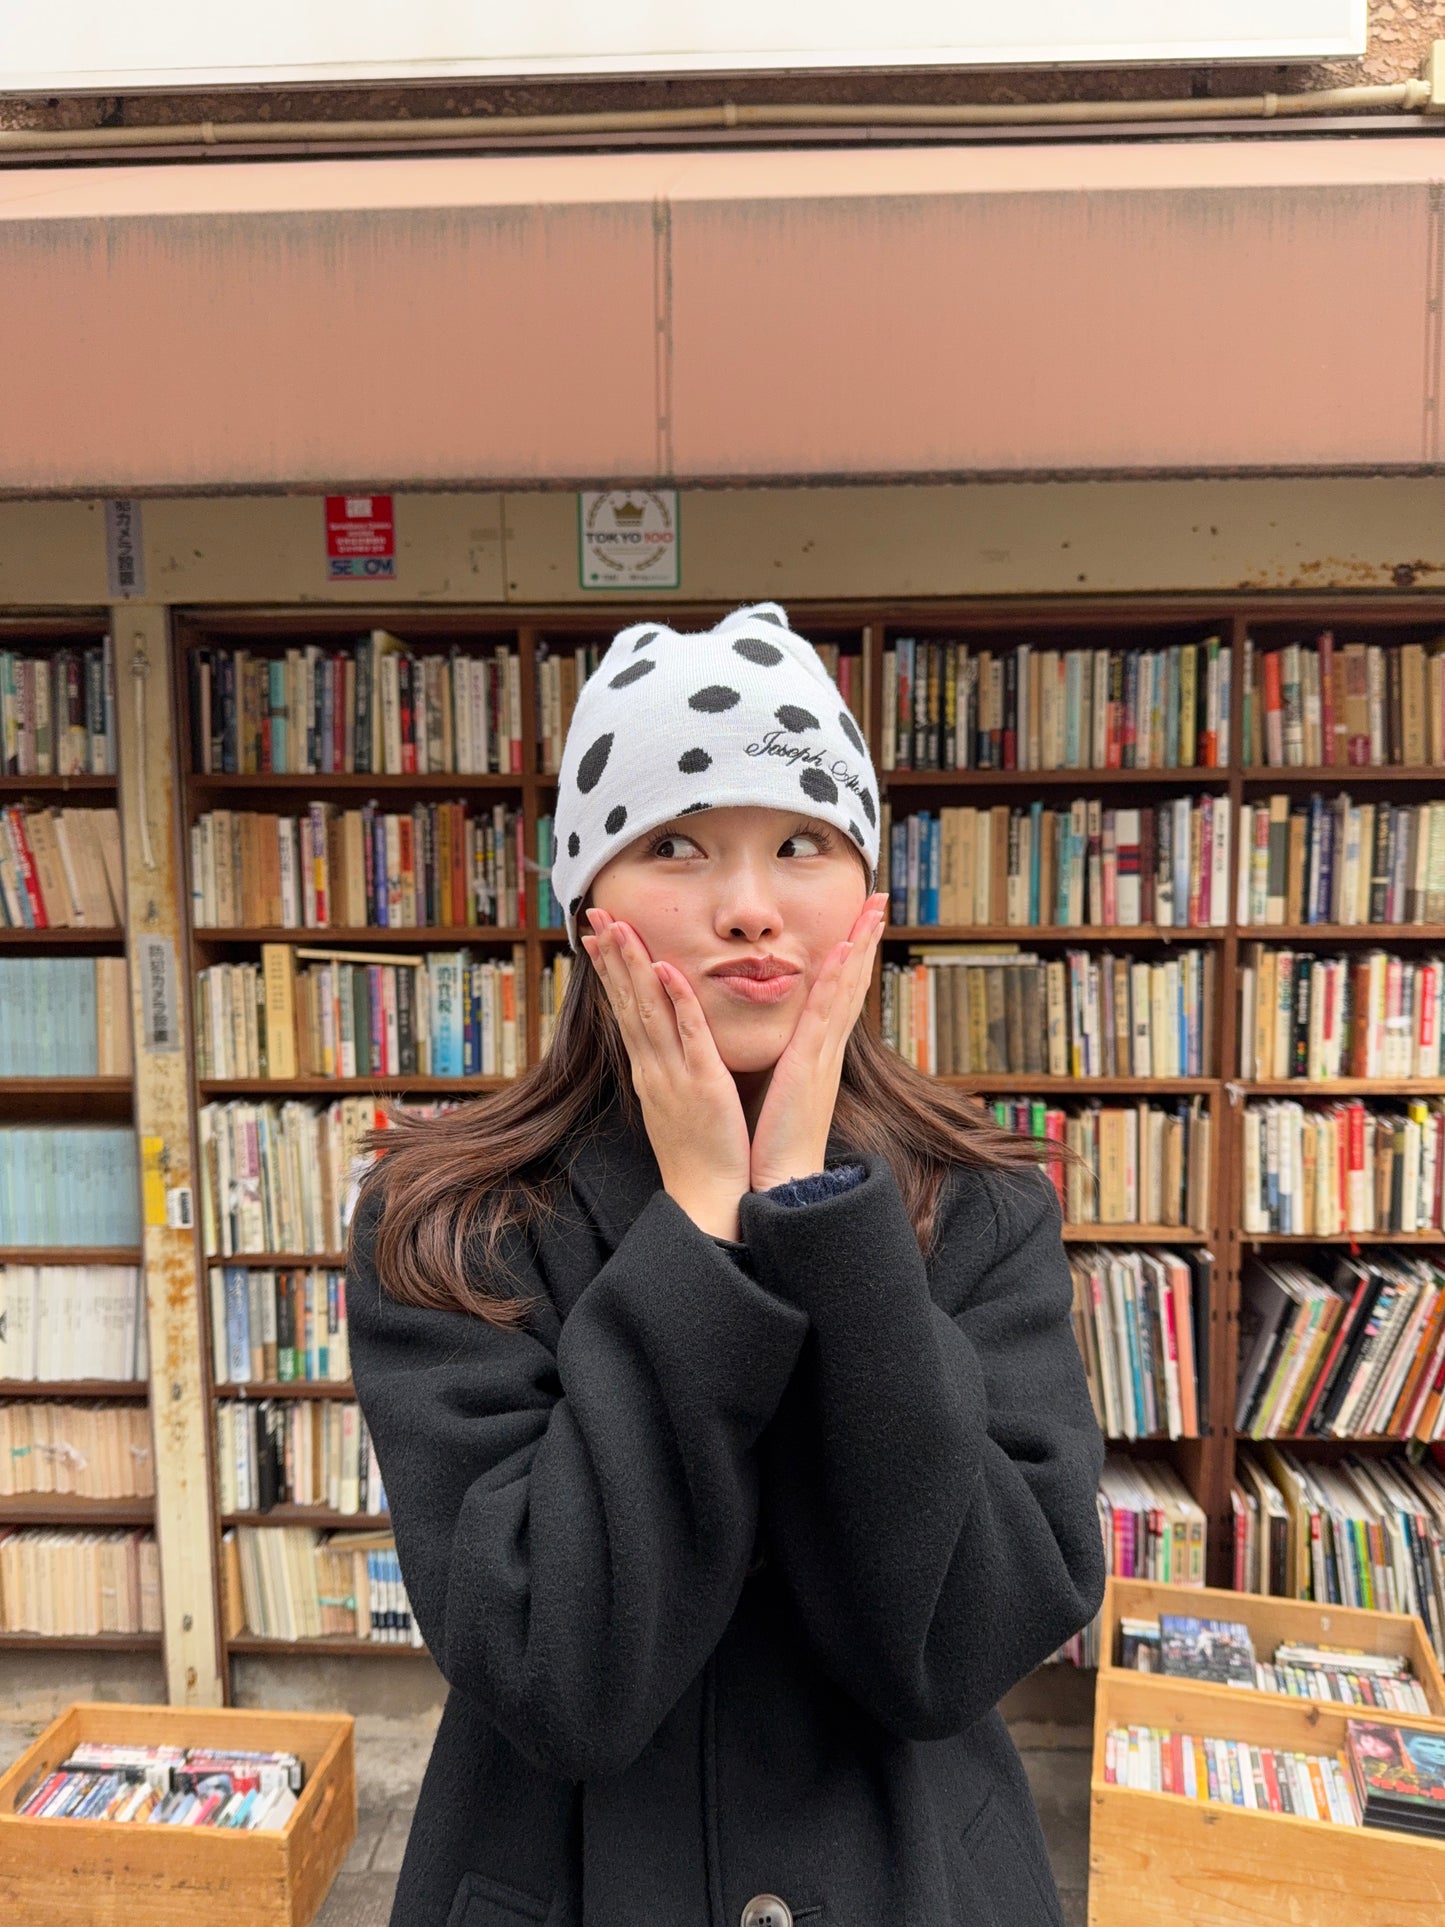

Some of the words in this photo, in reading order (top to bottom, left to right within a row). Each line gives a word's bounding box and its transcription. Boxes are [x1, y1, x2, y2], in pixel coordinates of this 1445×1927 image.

[586, 532, 642, 545] TOKYO
[331, 558, 393, 575] SECOM
[743, 731, 827, 767] Joseph
